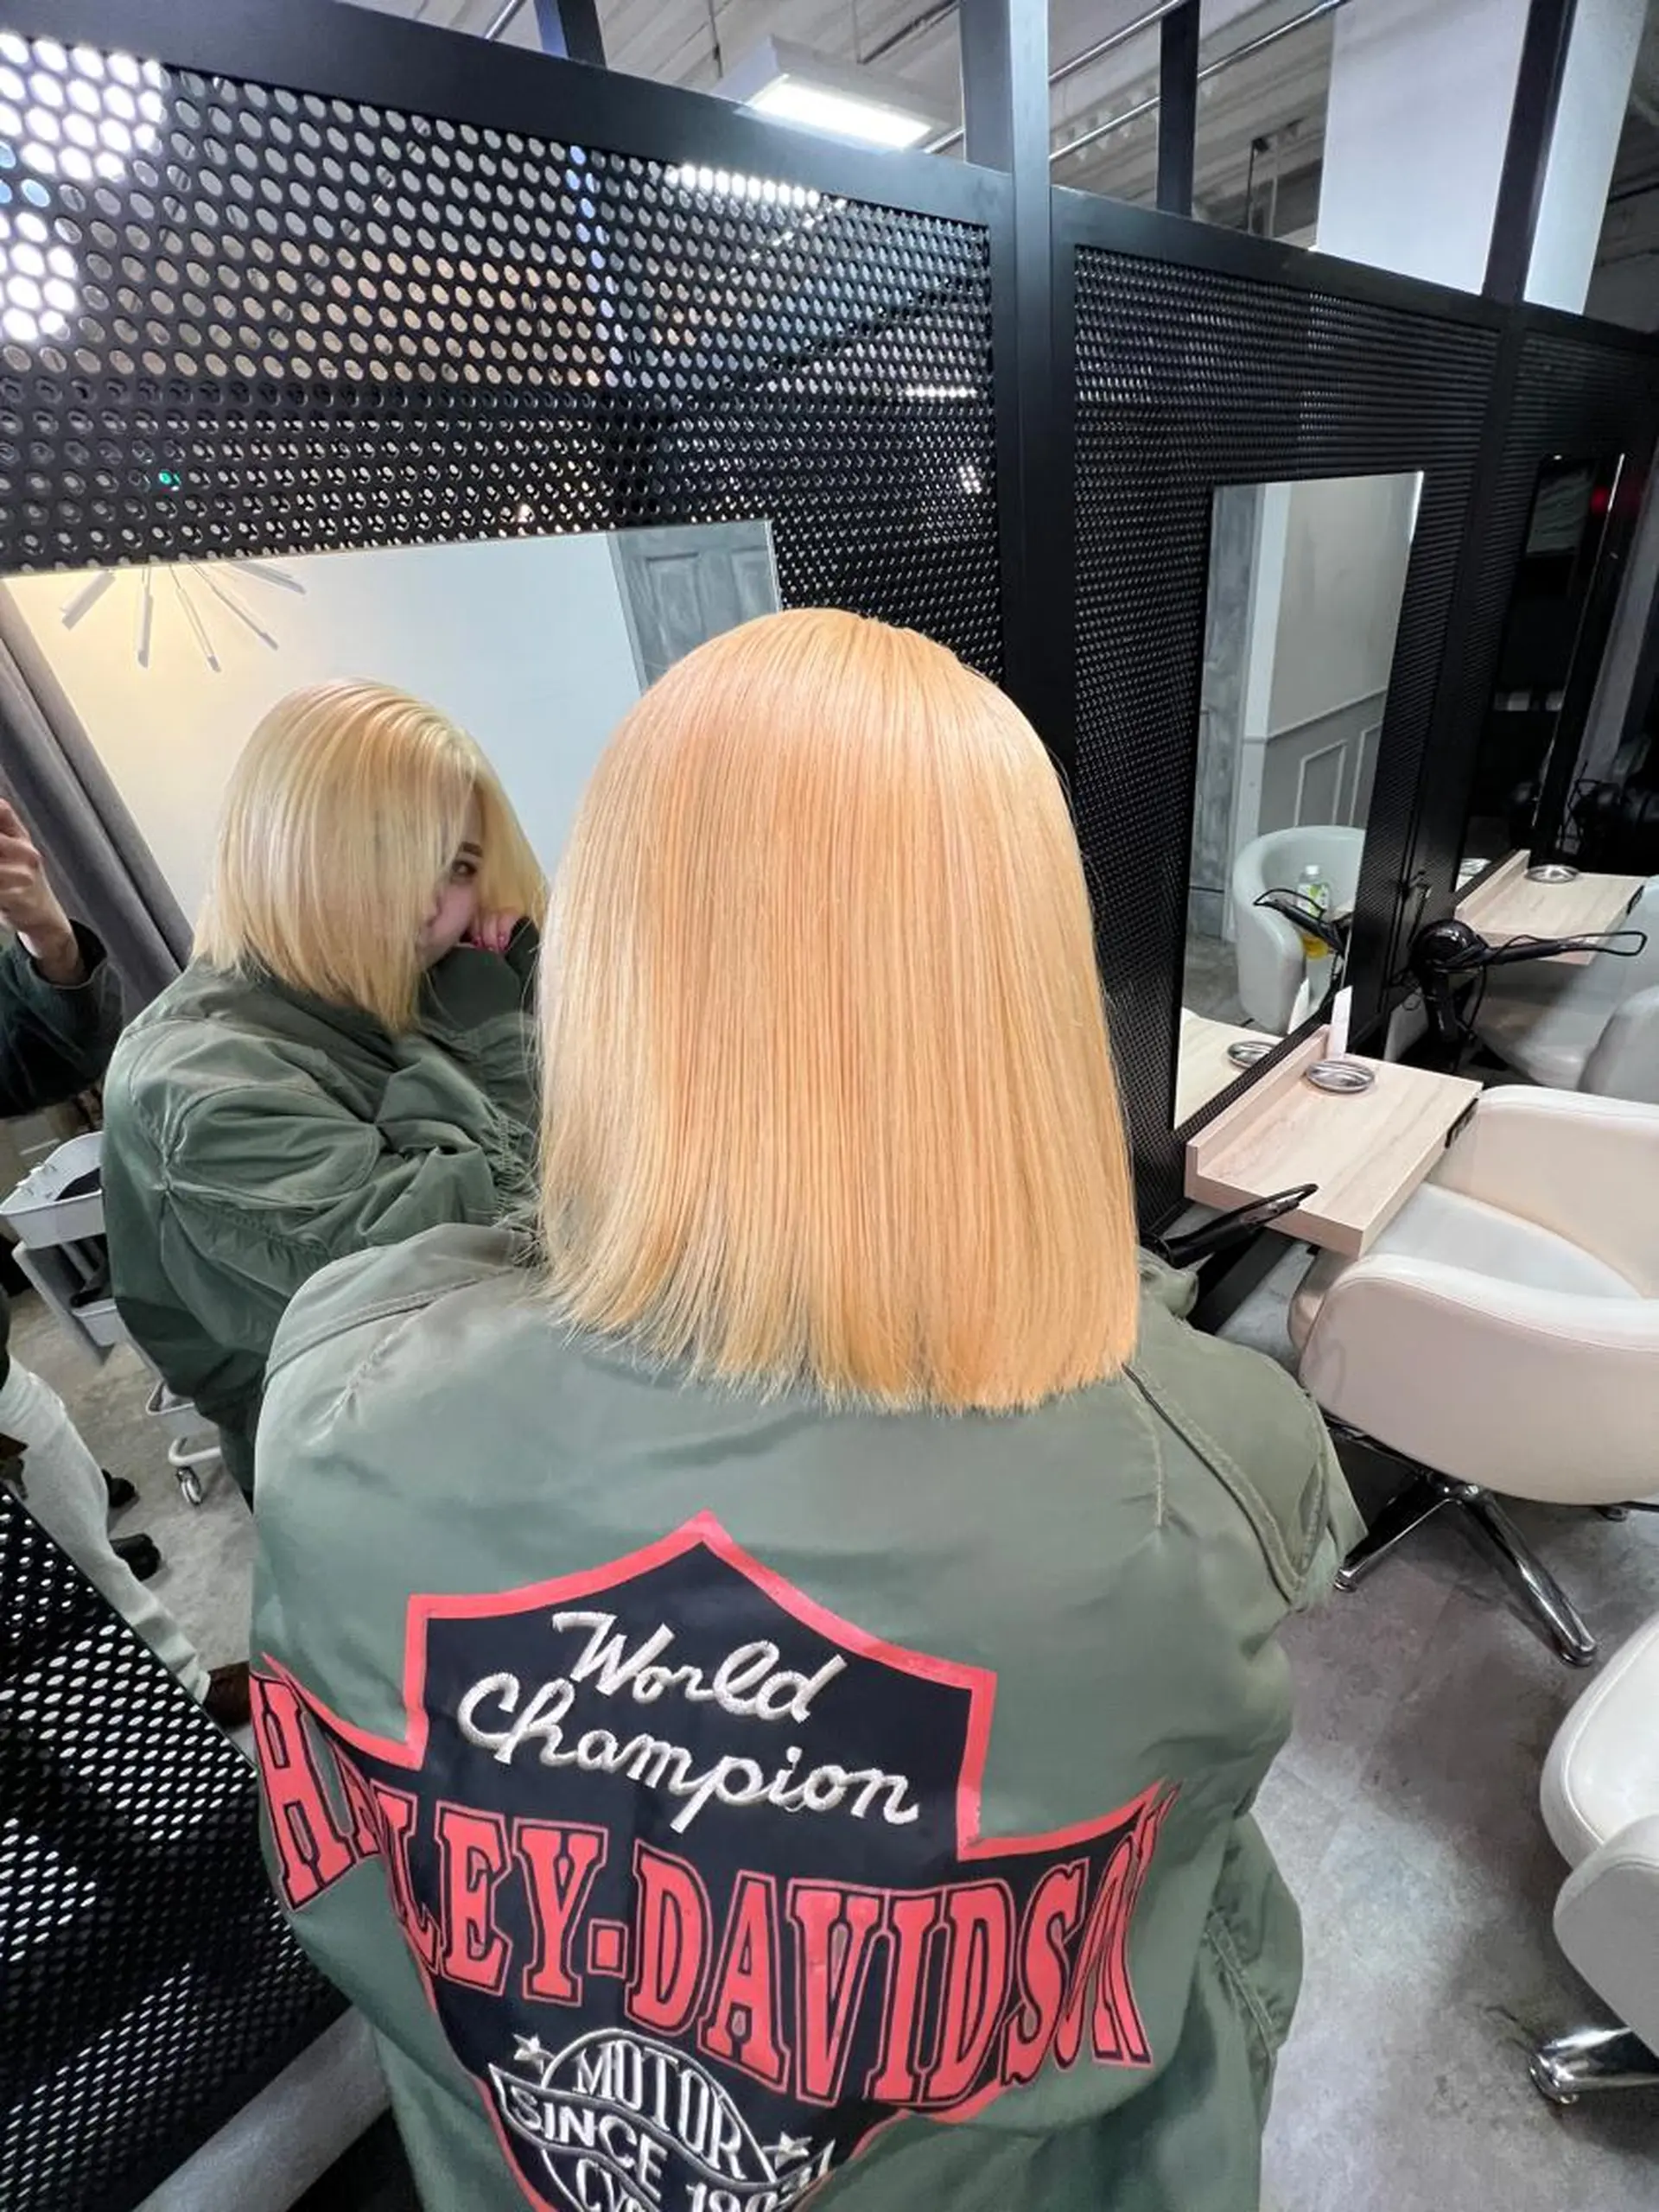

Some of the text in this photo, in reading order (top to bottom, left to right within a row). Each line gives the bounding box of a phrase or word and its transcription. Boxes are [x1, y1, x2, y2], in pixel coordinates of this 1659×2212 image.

[551, 1611, 849, 1724] World
[457, 1672, 919, 1834] Champion
[511, 2084, 669, 2202] SINCE
[572, 2039, 748, 2181] MOTOR
